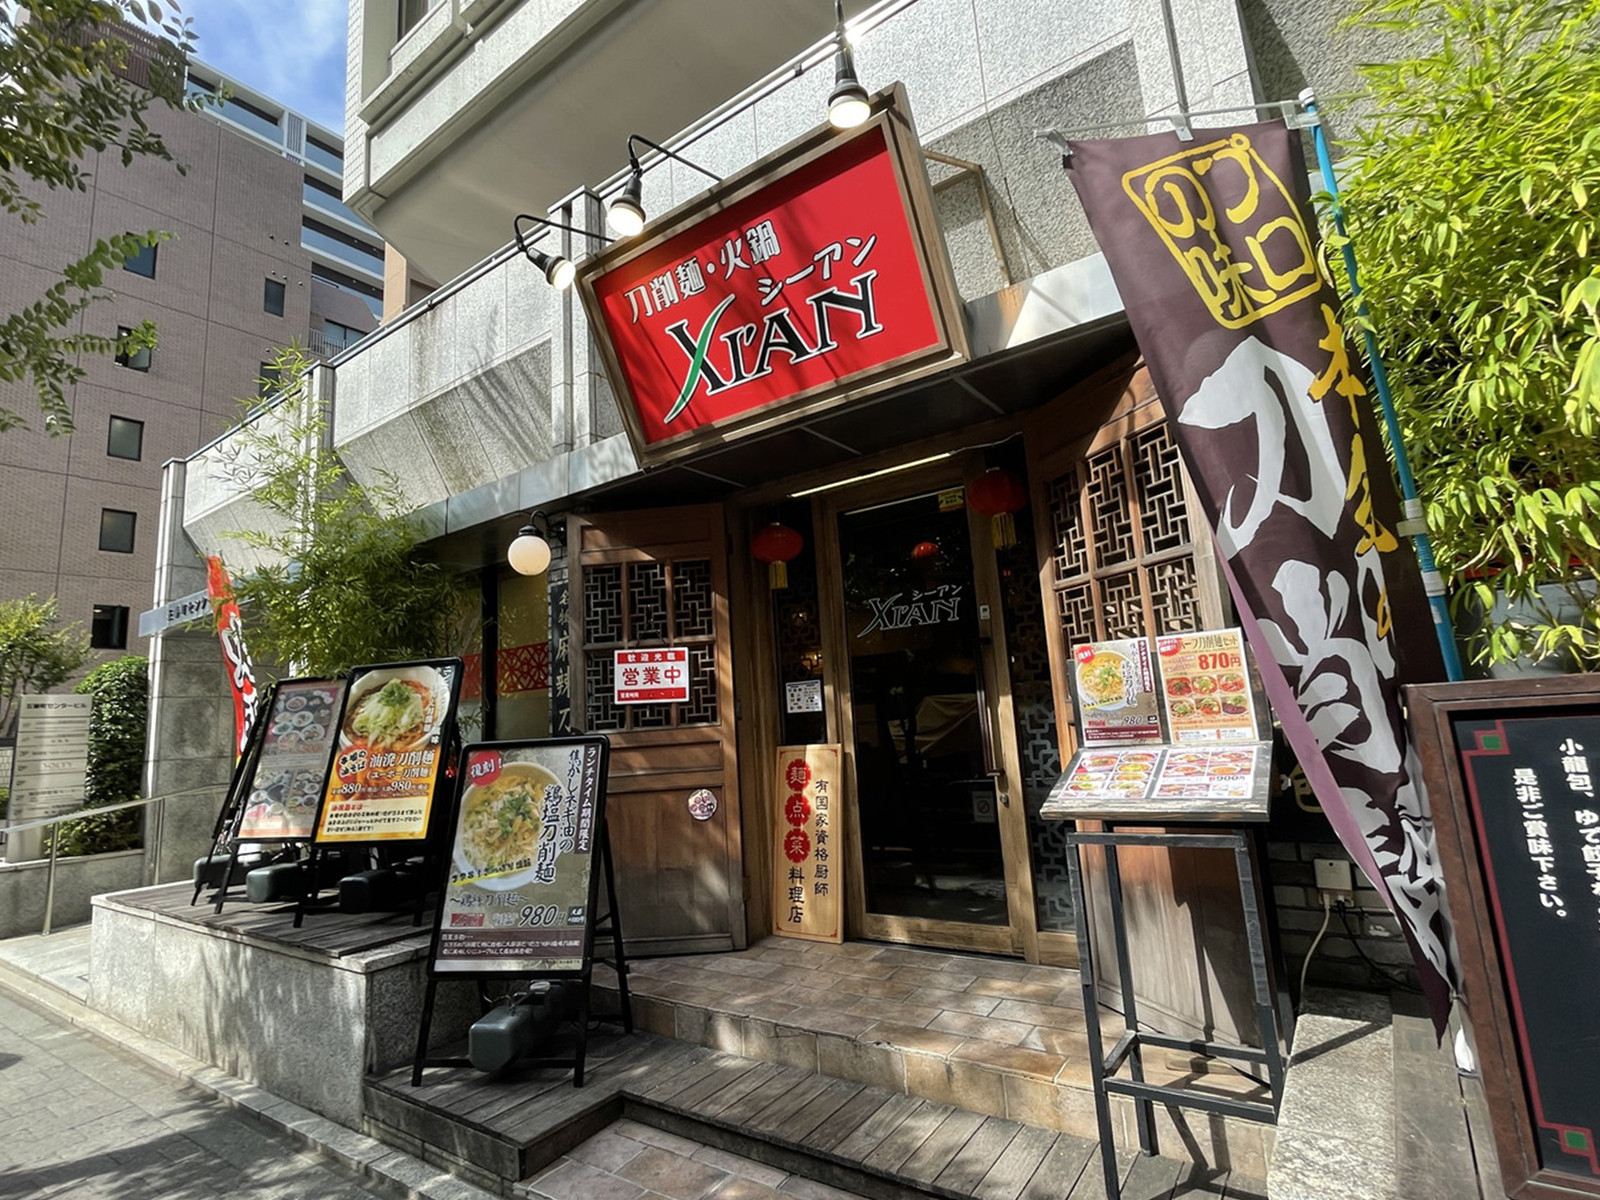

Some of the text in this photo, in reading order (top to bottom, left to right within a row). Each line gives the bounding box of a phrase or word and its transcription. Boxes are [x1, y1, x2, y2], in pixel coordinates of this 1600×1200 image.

[757, 235, 878, 307] シーアン
[911, 583, 964, 600] シーアン
[622, 665, 682, 687] 営業中
[533, 784, 563, 884] 鶏塩刀削麺
[559, 749, 582, 853] 焦がしネギ油の
[1513, 767, 1568, 918] 是非ご賞味下さい。
